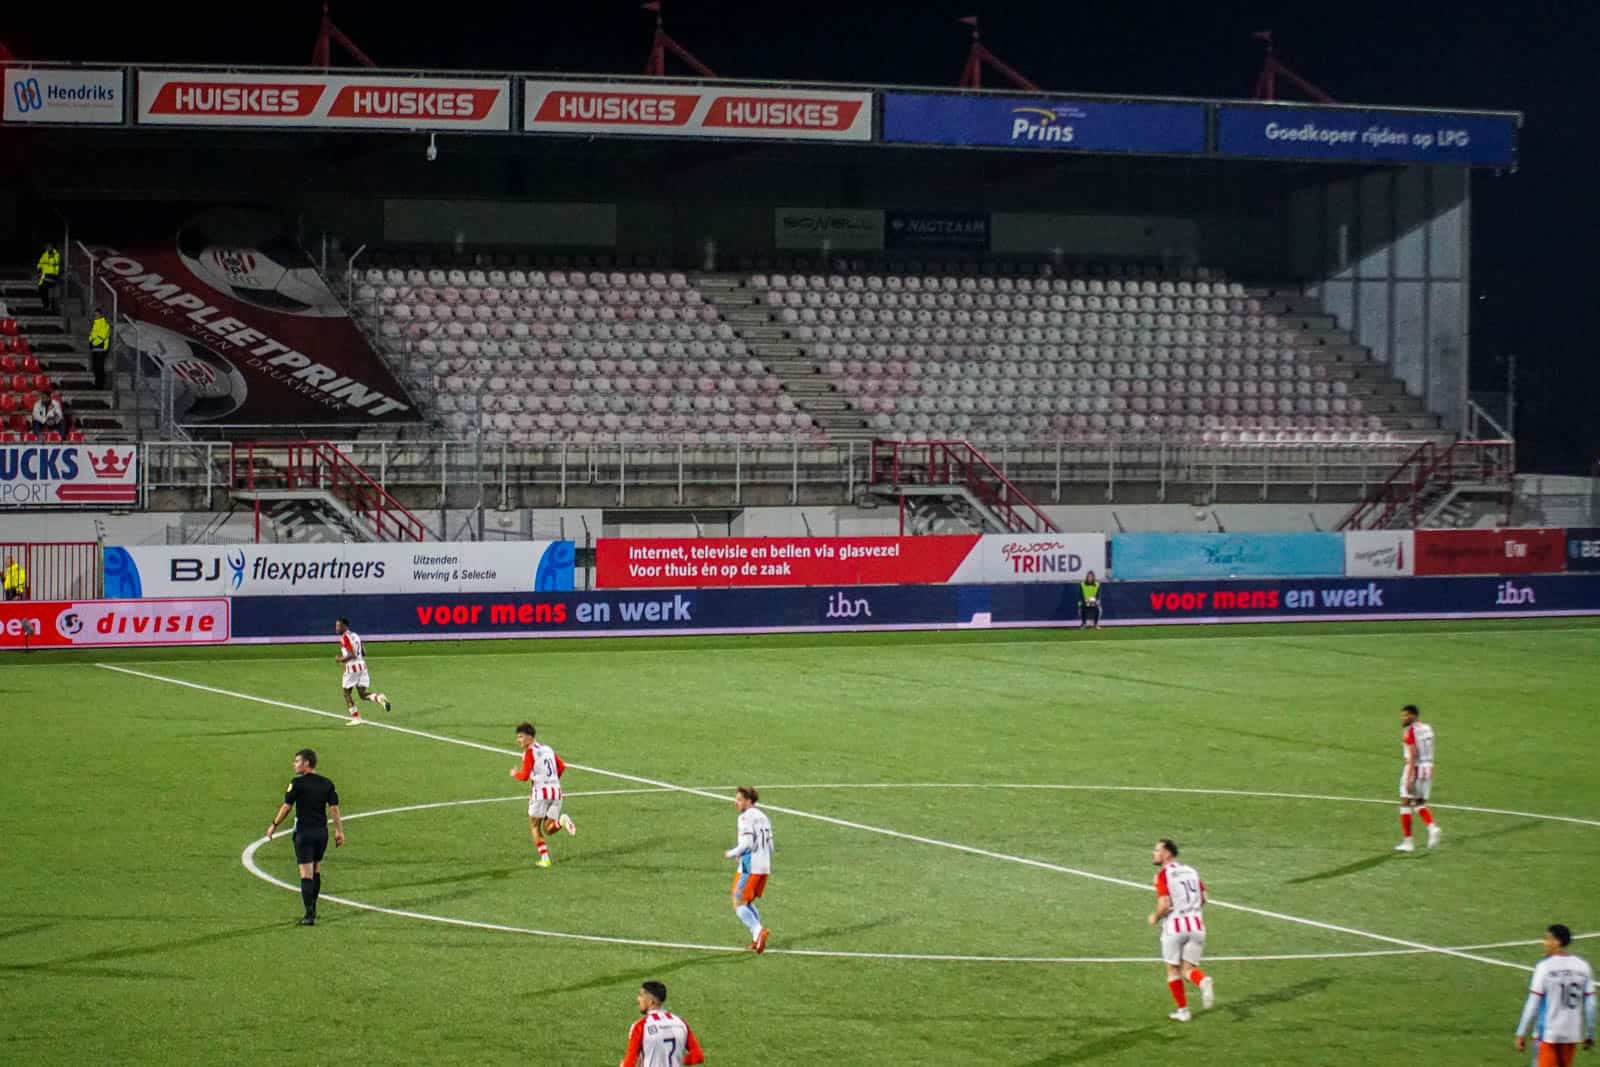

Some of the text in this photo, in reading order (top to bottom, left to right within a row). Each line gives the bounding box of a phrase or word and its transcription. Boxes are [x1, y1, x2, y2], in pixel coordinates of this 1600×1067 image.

[47, 84, 114, 100] Hendriks
[175, 86, 299, 112] HUISKES
[353, 91, 475, 116] HUISKES
[559, 95, 676, 121] HUISKES
[725, 101, 839, 126] HUISKES
[1011, 117, 1074, 142] Prins
[1265, 122, 1470, 149] Goedkoper rijden op LPG
[413, 554, 458, 566] Uitzenden
[629, 543, 900, 560] Internet, televisie en bellen via glasvezel
[1012, 554, 1082, 573] TRINED
[170, 556, 386, 585] BJ flexpartners
[413, 568, 497, 582] Werving & Selectie
[629, 561, 791, 578] Voor thuis én op de zaak
[826, 591, 872, 618] ibn
[1150, 582, 1384, 611] voor mens en werk
[1495, 581, 1536, 605] ibn
[417, 595, 692, 625] voor mens en werk
[96, 612, 215, 635] divisie
[663, 1037, 676, 1067] 7
